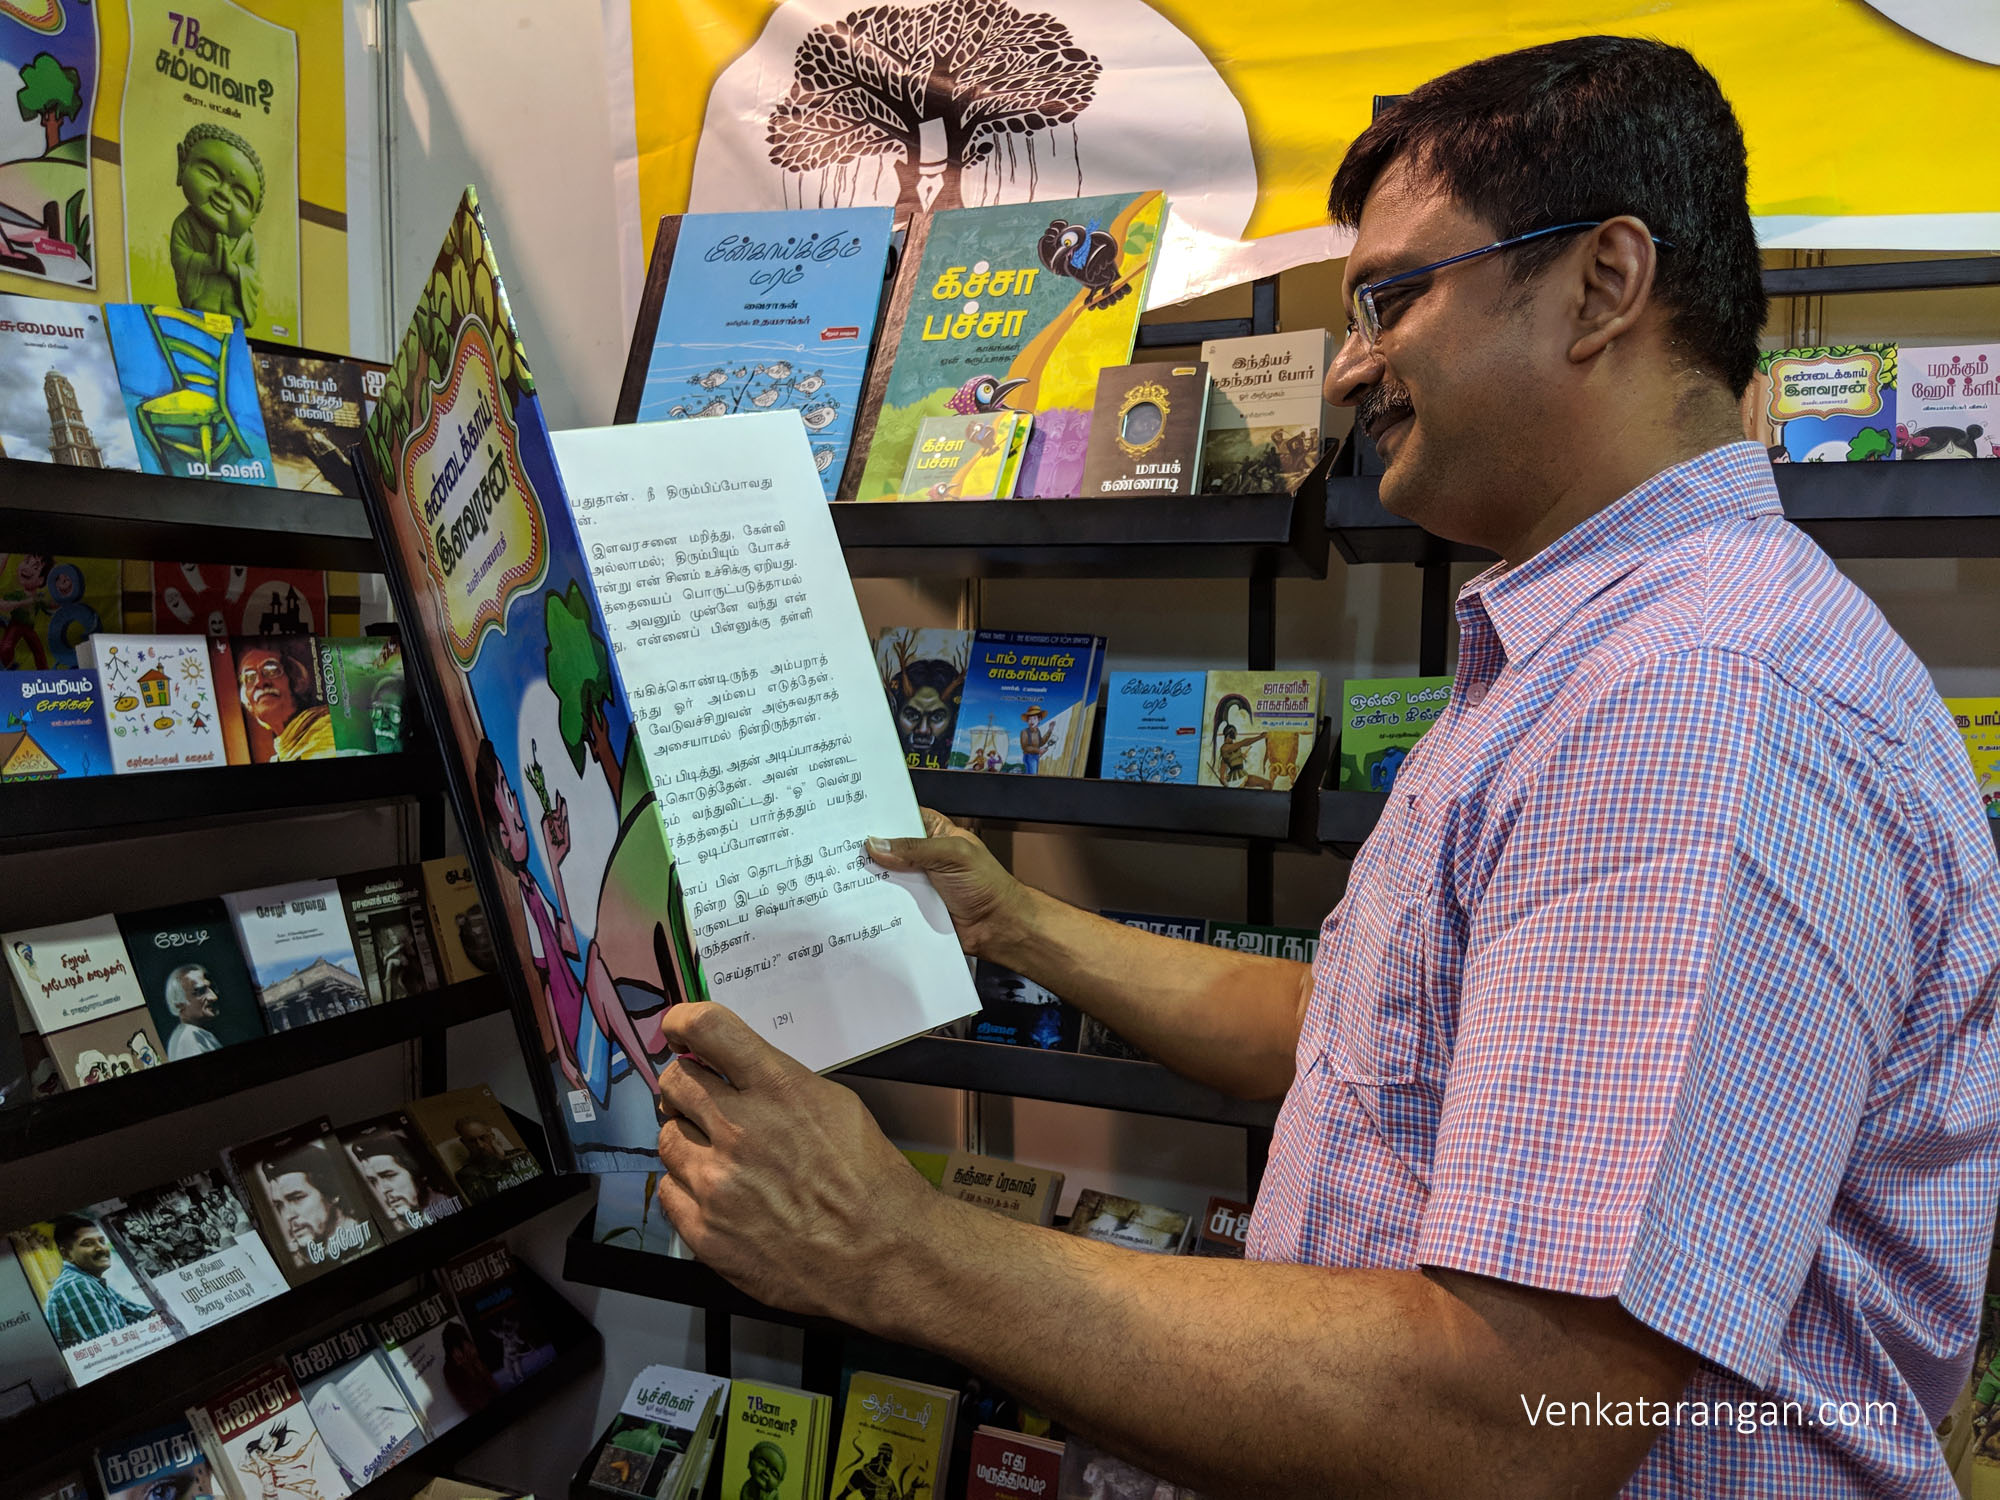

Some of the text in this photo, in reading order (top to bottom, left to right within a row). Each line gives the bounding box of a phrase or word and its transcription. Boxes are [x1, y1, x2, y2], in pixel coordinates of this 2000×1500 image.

[168, 12, 231, 70] 7Bனா
[155, 47, 274, 114] சும்மாவா?
[705, 231, 861, 262] மீன்காய்க்கும்
[750, 264, 804, 295] மரம்
[932, 260, 1040, 300] கிச்சா
[922, 301, 1028, 341] பச்சா
[1232, 352, 1292, 370] இந்தியச்
[1278, 366, 1315, 381] போர்
[1928, 355, 1988, 378] பறக்கும்
[1784, 369, 1867, 383] சுண்டைக்காய்
[1784, 381, 1866, 397] இளவரசன்
[1912, 378, 1955, 400] ஹேர்
[425, 389, 492, 525] சுண்டைக்காய்
[921, 436, 965, 452] கிச்சா
[188, 460, 266, 479] மடவளி
[917, 452, 960, 470] பச்சா
[1136, 460, 1181, 474] மாயக்
[648, 487, 655, 502] நீ
[667, 478, 772, 500] திரும்பிப்போவது
[1101, 475, 1179, 492] கண்ணாடி
[436, 444, 510, 578] இளவரசன்
[592, 536, 677, 560] இளவரசனை
[743, 521, 785, 536] கேள்வி
[676, 547, 739, 567] திரும்பியும்
[748, 539, 791, 553] போகச்
[636, 560, 797, 588] என் சினம் உச்சிக்கு ஏறியது.
[682, 575, 802, 601] பொருட்படுத்தாமல்
[627, 592, 807, 630] அவனும் முன்னே வந்து என்
[636, 608, 813, 647] என்னைப் பின்னுக்கு தள்ளி
[770, 654, 829, 674] அம்பறாத்
[986, 652, 1075, 667] டாம் சாயரின்
[21, 676, 94, 699] துப்பறியும்
[989, 667, 1066, 682] சாகசங்கள்
[674, 672, 834, 716] ஓர் அம்பை எடுத்தேன்.
[1256, 697, 1309, 711] சாகசங்கள்
[649, 690, 840, 736] வேடுவச்சிறுவன் அஞ்சுவதாகத்
[1350, 713, 1400, 729] குண்டு
[654, 712, 820, 757] அசையாமல் நின்றிருந்தான்.
[676, 765, 724, 782] பிடித்து,
[726, 756, 760, 772] அதன்
[765, 734, 852, 764] அடிப்பாகத்தால்
[762, 766, 798, 784] அவன்
[808, 758, 857, 772] மண்டை
[692, 793, 778, 820] வந்துவிட்டது.
[816, 772, 862, 788] வென்று
[750, 800, 816, 826] பார்த்ததும்
[698, 827, 794, 860] ஓடிப்போனான்.
[716, 873, 740, 889] பின்
[748, 855, 814, 879] தொடர்ந்து
[694, 866, 840, 918] நின்ற இடம் ஒரு குடில்.
[755, 888, 828, 918] சிஷ்யர்களும்
[833, 870, 890, 894] கோபமாக
[154, 929, 210, 949] வேட்டி
[787, 944, 824, 963] என்று
[828, 916, 903, 946] கோபத்துடன்
